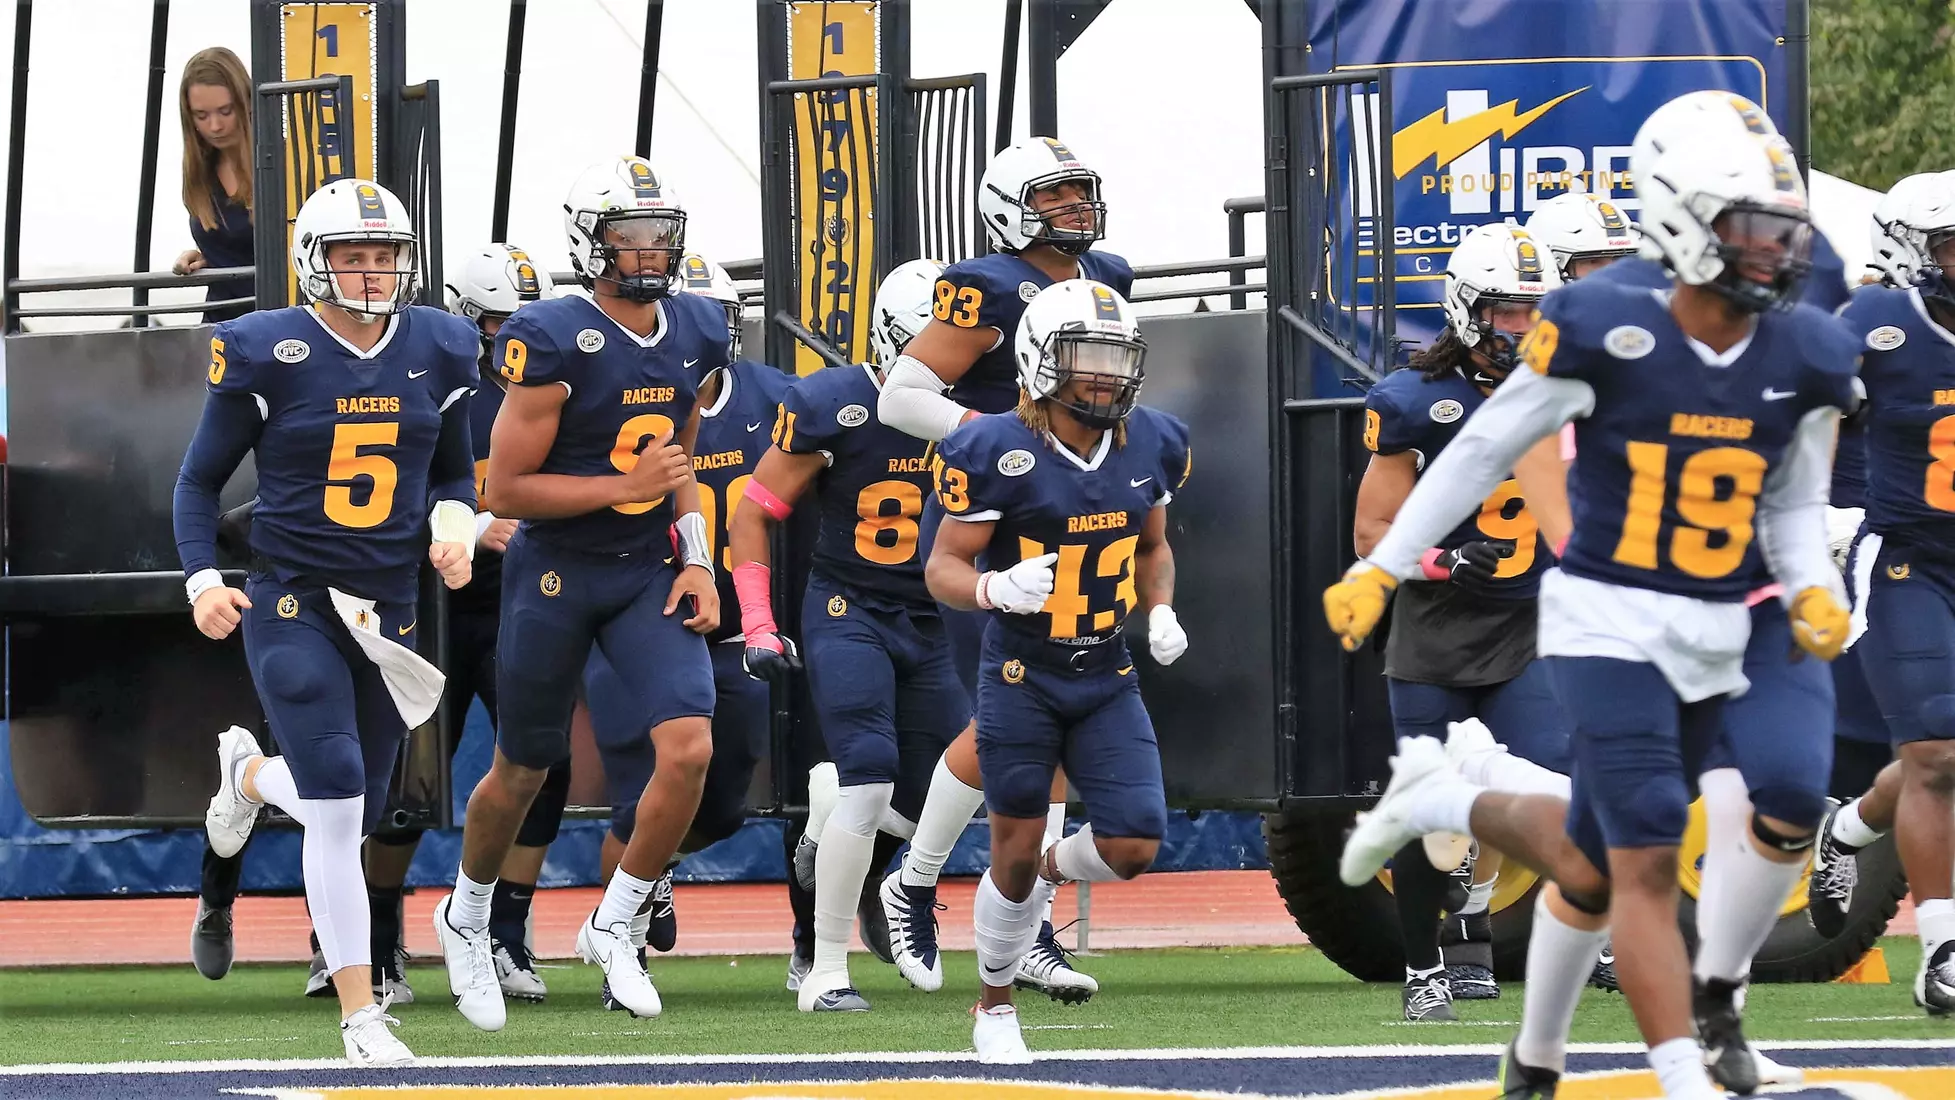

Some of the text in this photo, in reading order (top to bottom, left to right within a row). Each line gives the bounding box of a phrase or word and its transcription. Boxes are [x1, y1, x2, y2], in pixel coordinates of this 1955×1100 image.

[1421, 173, 1513, 195] PROUD
[933, 280, 983, 328] 93
[208, 337, 229, 385] 5
[500, 338, 528, 384] 9
[336, 397, 399, 414] RACERS
[622, 386, 676, 405] RACERS
[771, 402, 797, 453] 81
[1669, 413, 1754, 440] RACERS
[323, 422, 399, 528] 5
[693, 449, 744, 471] RACERS
[1067, 510, 1127, 533] RACERS
[1476, 478, 1539, 579] 9
[1612, 440, 1768, 579] 19
[1018, 534, 1140, 639] 43
